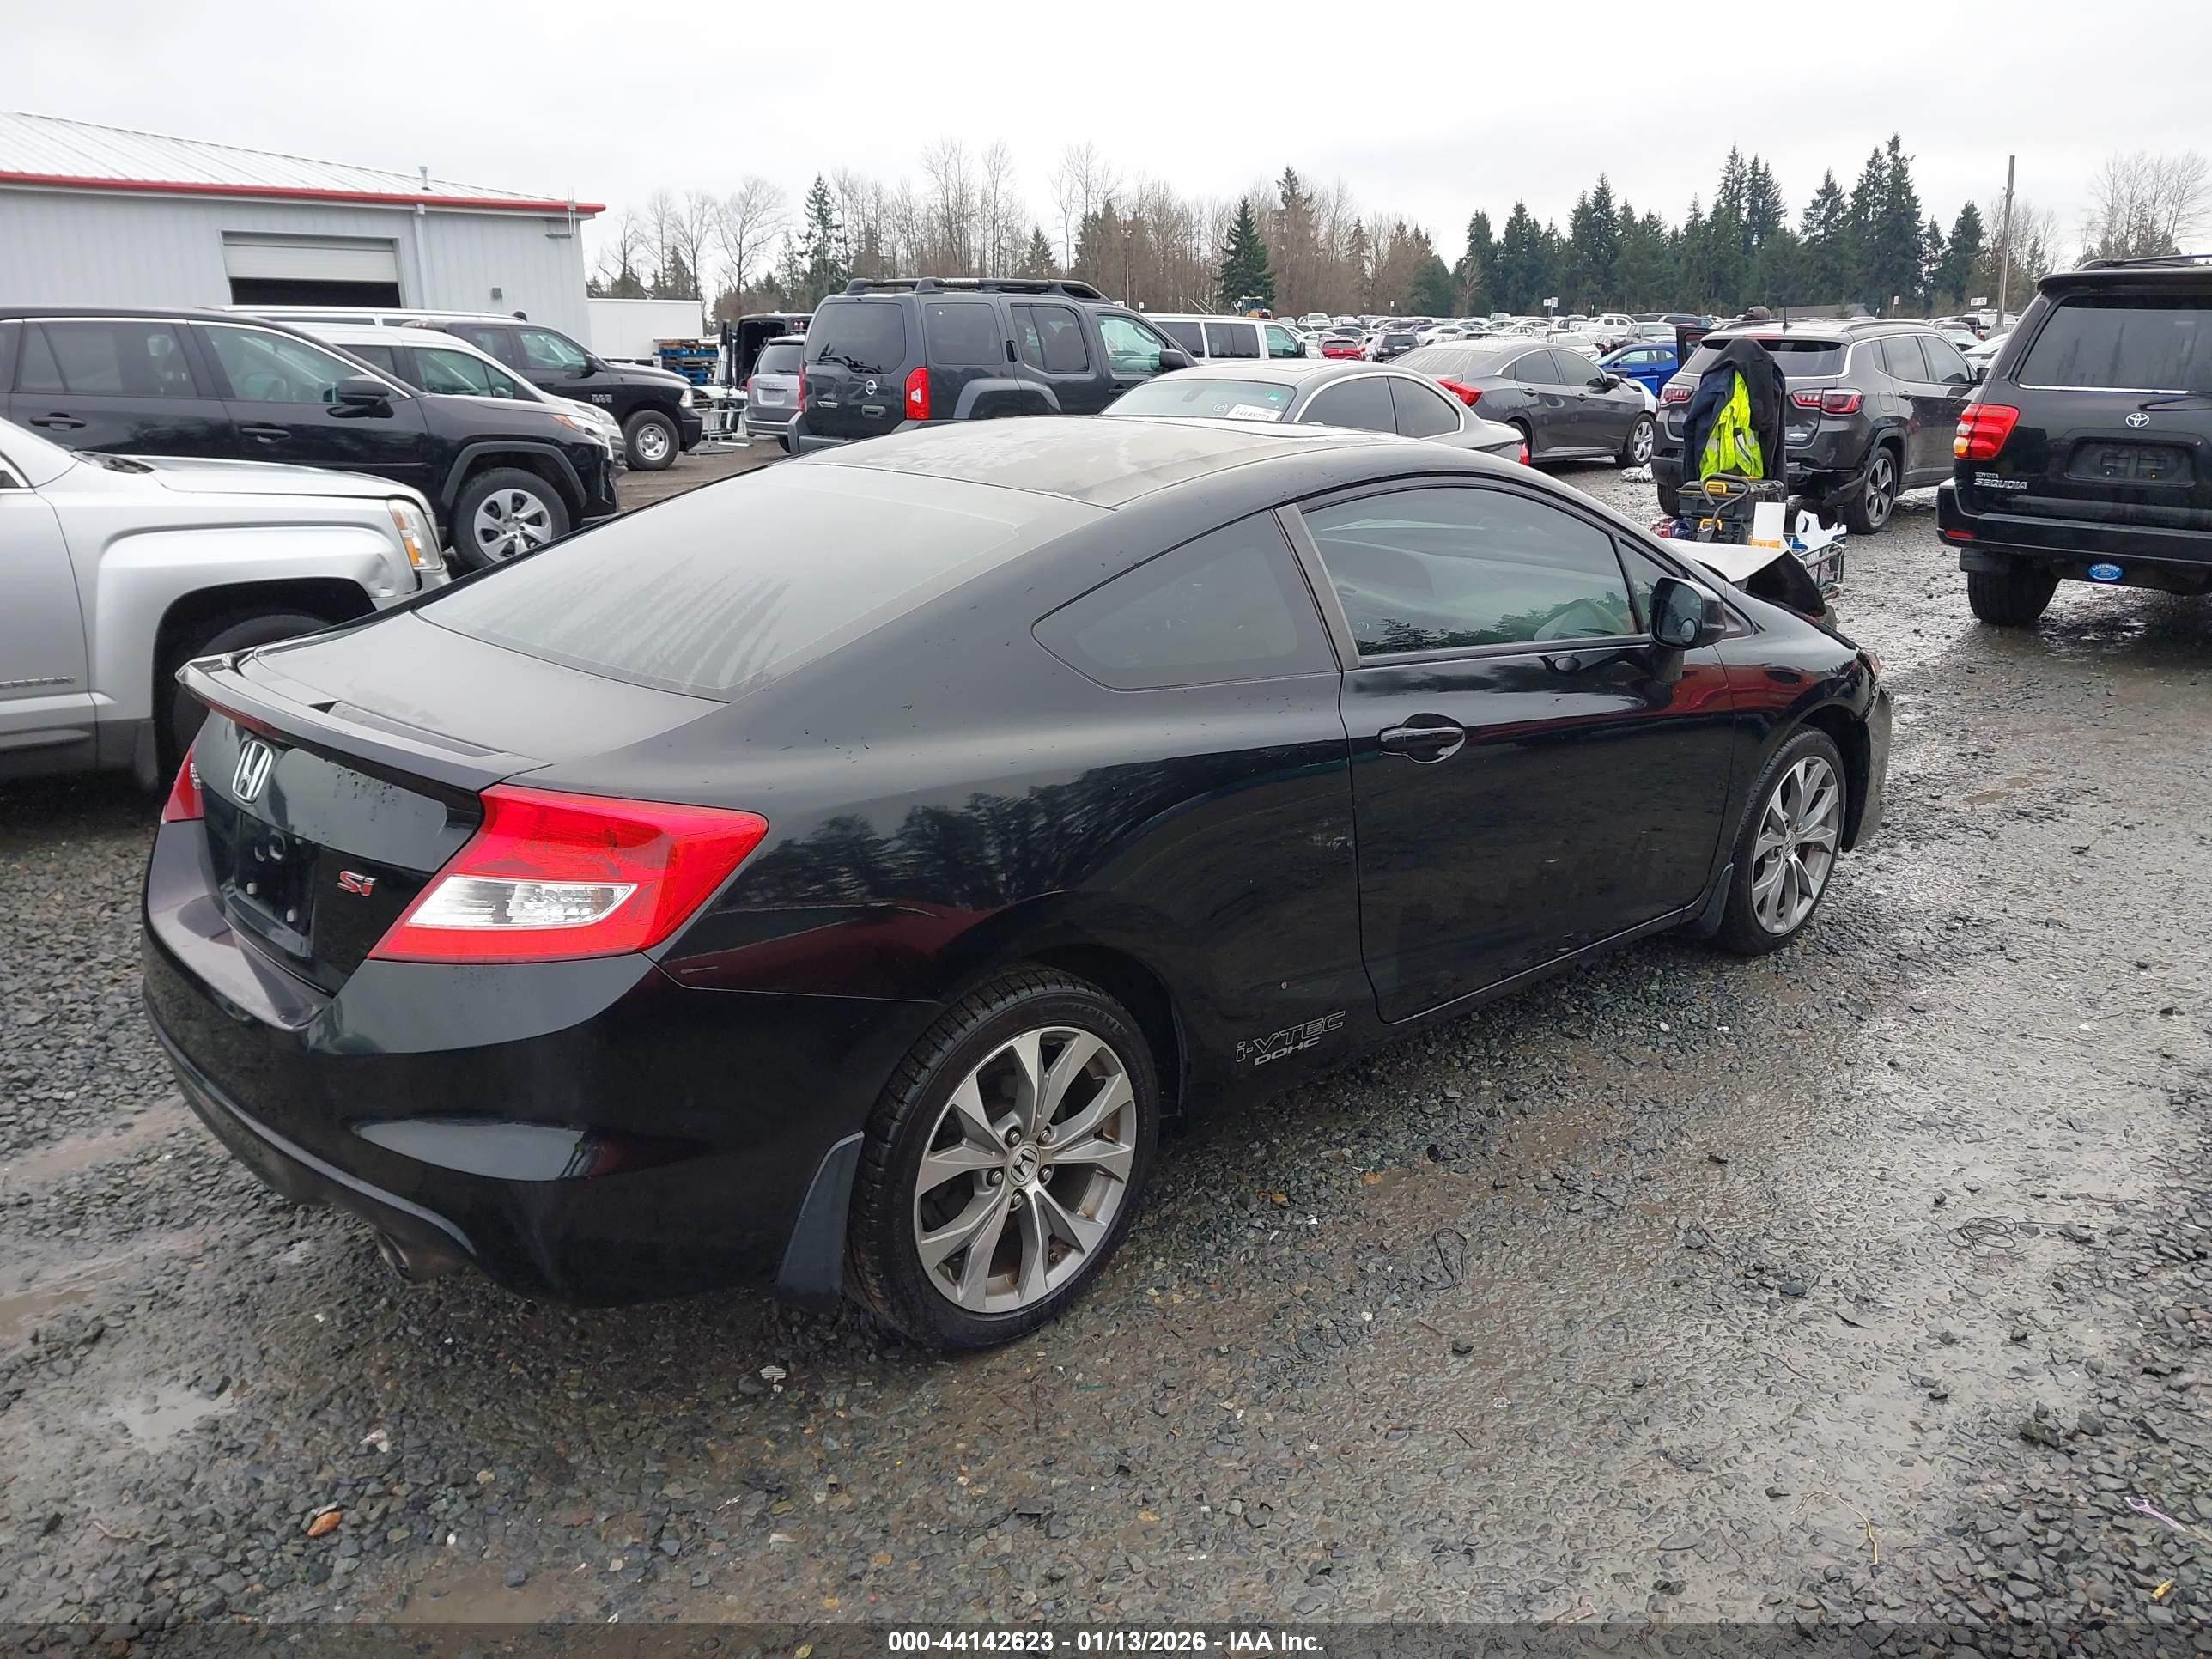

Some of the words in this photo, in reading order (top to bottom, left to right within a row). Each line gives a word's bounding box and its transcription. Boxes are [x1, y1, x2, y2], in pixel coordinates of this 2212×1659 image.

[1973, 478, 2027, 490] SEQUOIA
[337, 870, 378, 896] Si
[1236, 1010, 1346, 1063] i-VTEC
[1254, 1036, 1320, 1066] DOHC
